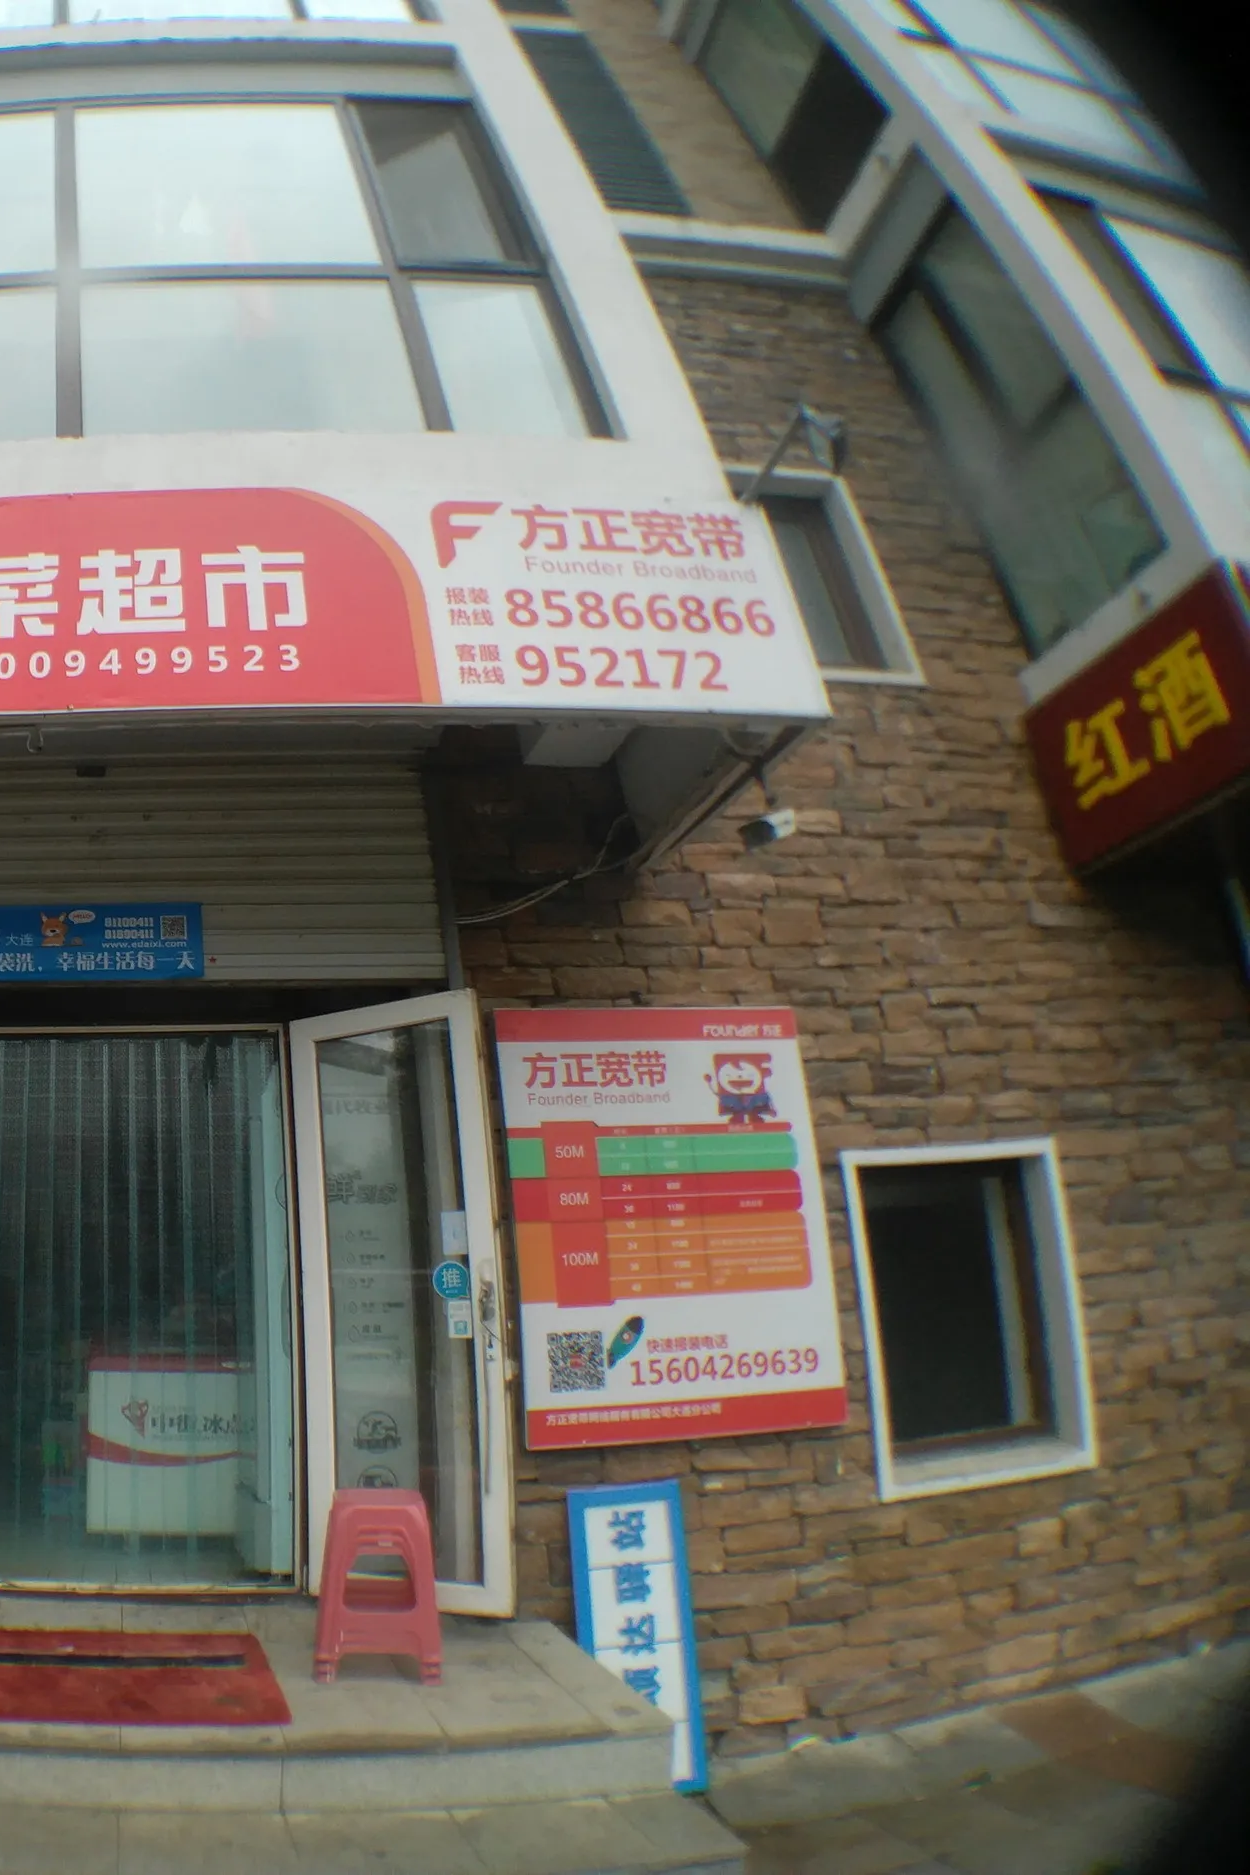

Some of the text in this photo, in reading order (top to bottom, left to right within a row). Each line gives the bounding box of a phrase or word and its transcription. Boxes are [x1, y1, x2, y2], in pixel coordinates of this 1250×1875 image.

[510, 504, 746, 561] 方正宽带
[524, 556, 757, 584] Founder Broadband
[448, 608, 495, 626] 热线
[504, 588, 776, 637] 85866866
[455, 643, 501, 662] 客服
[459, 665, 505, 685] 热线
[515, 644, 729, 691] 952172
[1065, 629, 1231, 810] 红酒
[102, 939, 187, 949] www.edaixi.com
[521, 1051, 667, 1089] 方正宽带
[528, 1090, 670, 1106] Founder Broadband
[555, 1145, 584, 1160] 50M
[559, 1193, 589, 1206] 80M
[562, 1252, 599, 1267] 100M
[441, 1268, 462, 1288] 推
[630, 1348, 819, 1386] 15604269639
